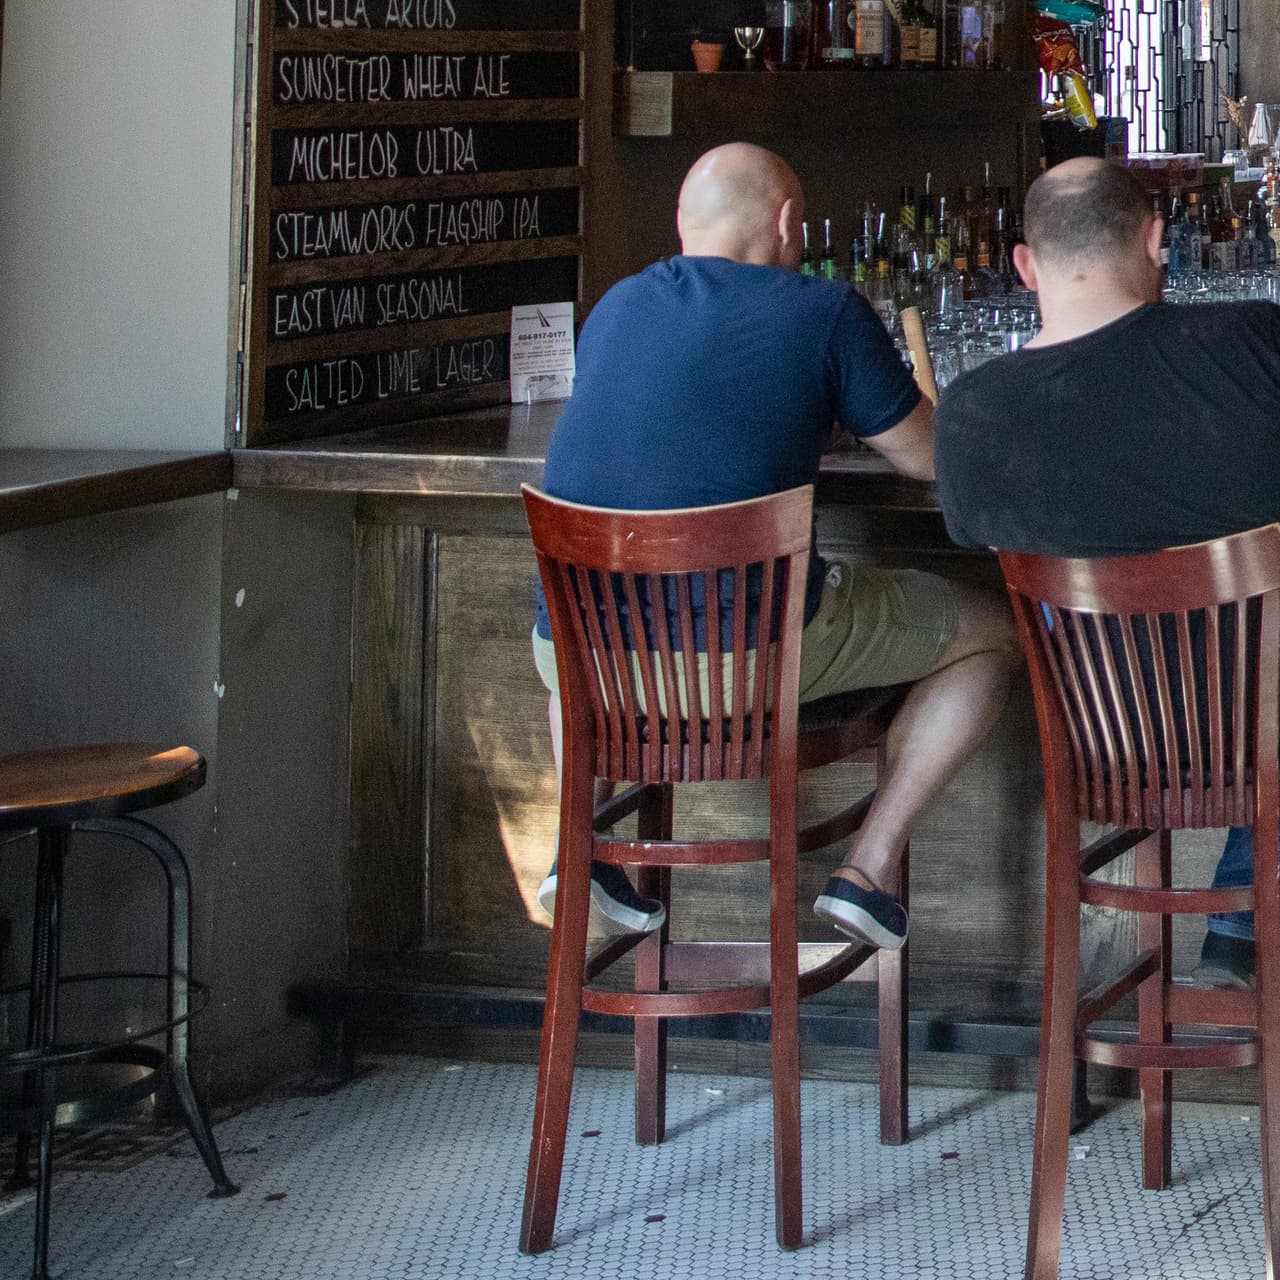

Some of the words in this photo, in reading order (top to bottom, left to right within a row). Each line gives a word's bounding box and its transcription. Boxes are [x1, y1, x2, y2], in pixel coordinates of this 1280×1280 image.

[280, 54, 391, 101] SUNSETTER
[403, 56, 464, 99] WHEAT
[473, 54, 511, 96] ALE
[289, 132, 397, 183] MICHELOB
[417, 127, 478, 176] ULTRA
[276, 205, 416, 260] STEAMWORKS
[426, 200, 504, 247] FLAGSHIP
[513, 196, 540, 237] IPA
[275, 285, 327, 335] EAST
[329, 285, 365, 325] VAN
[377, 274, 468, 322] SEASONAL
[285, 359, 362, 412] SALTED
[377, 348, 419, 398] LIME
[435, 339, 494, 387] LAGER
